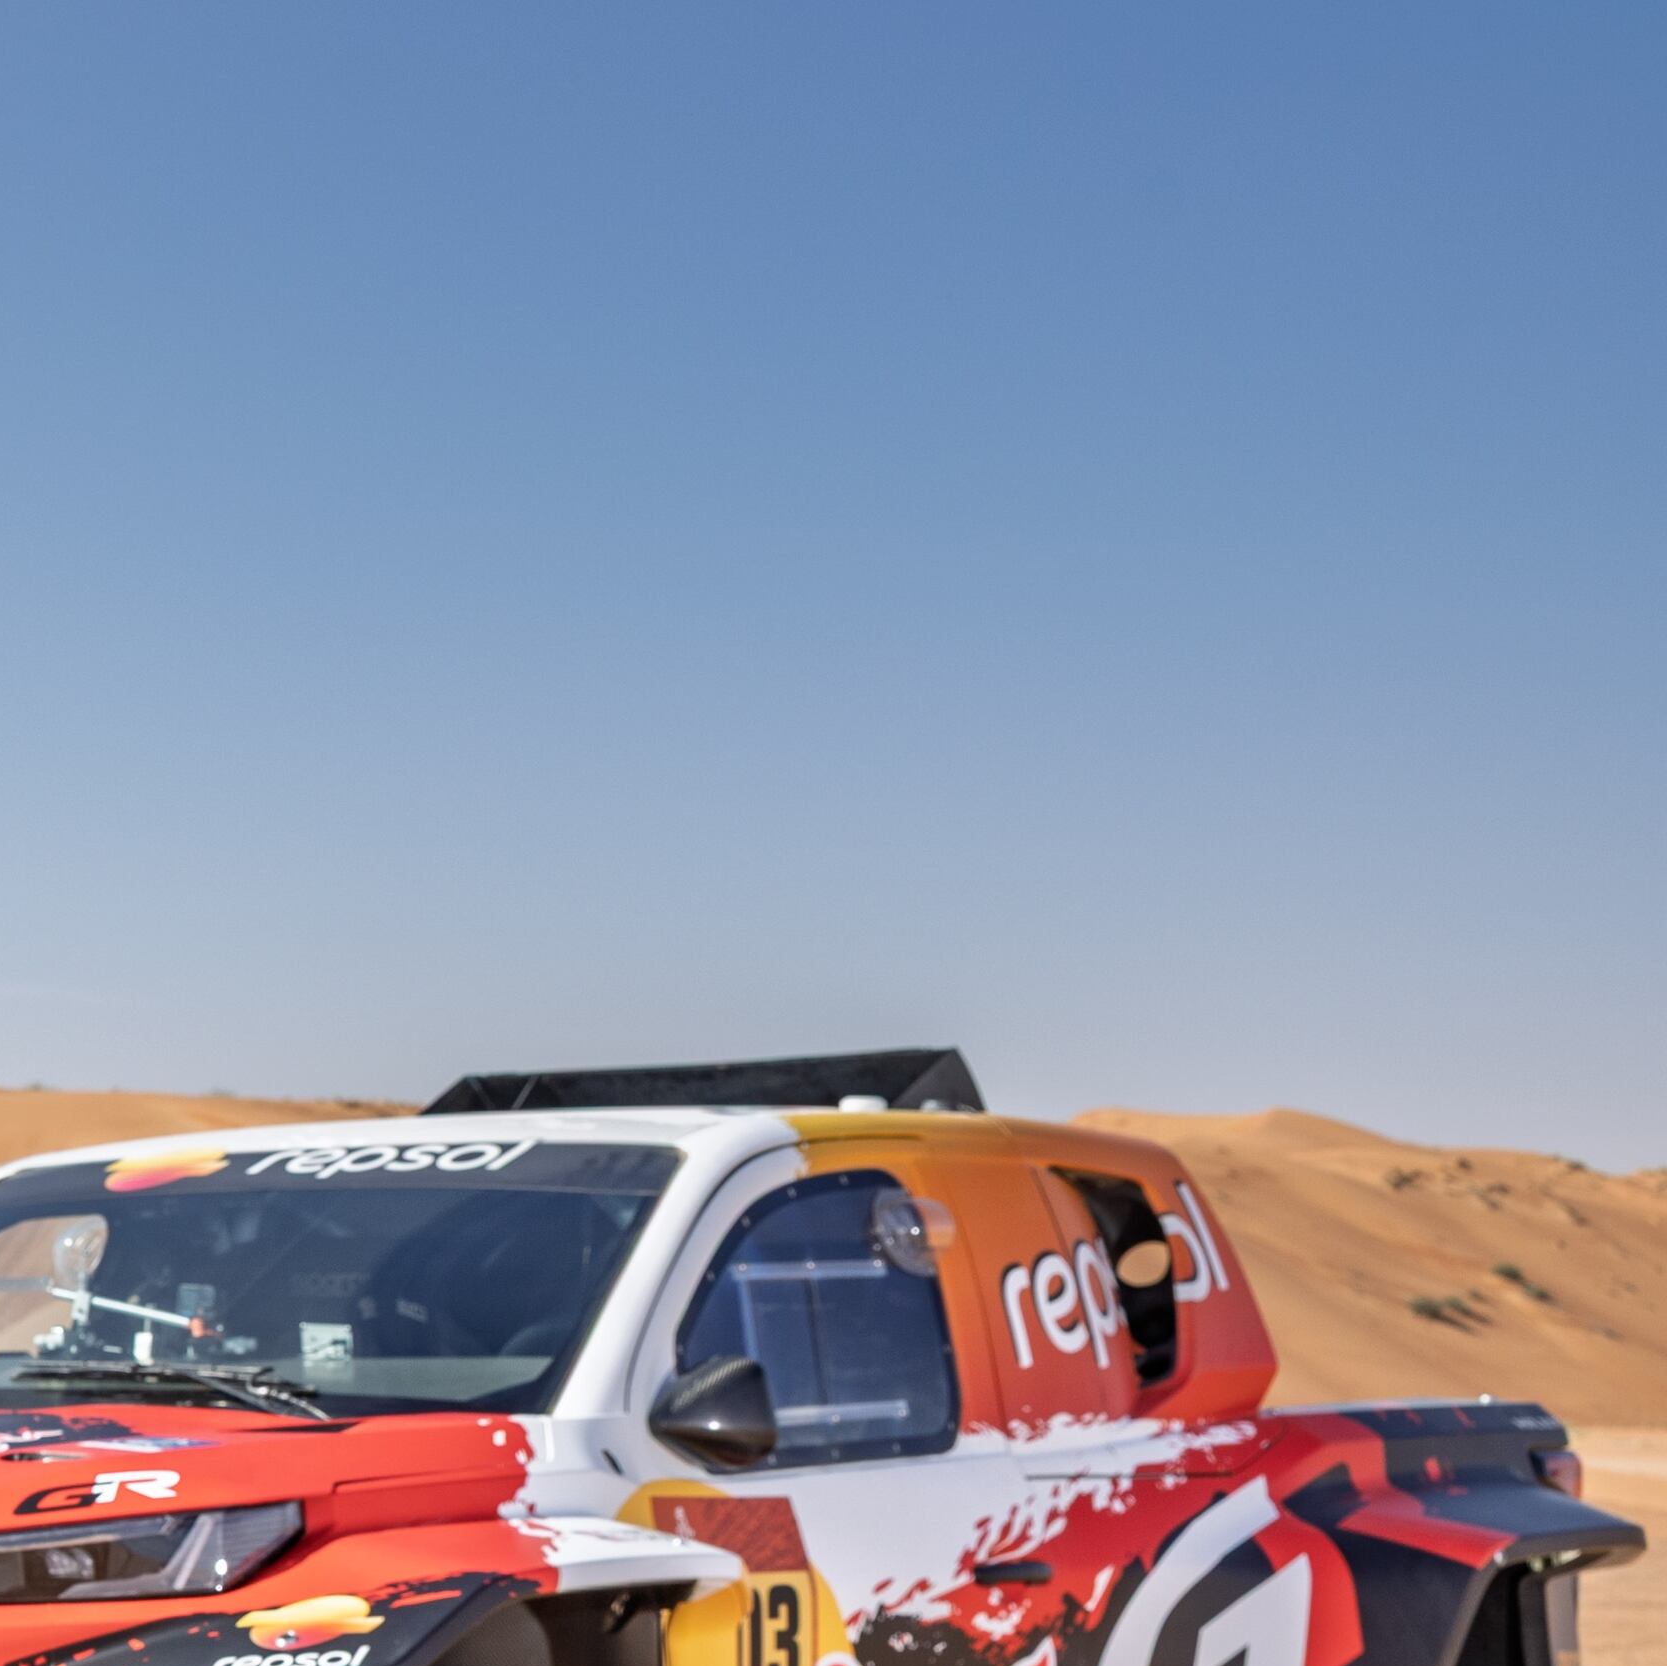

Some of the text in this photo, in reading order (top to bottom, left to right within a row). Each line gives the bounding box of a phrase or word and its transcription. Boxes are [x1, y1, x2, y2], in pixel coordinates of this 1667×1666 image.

[245, 1139, 539, 1178] repsol
[1000, 1181, 1229, 1370] repol
[12, 1469, 181, 1515] GR
